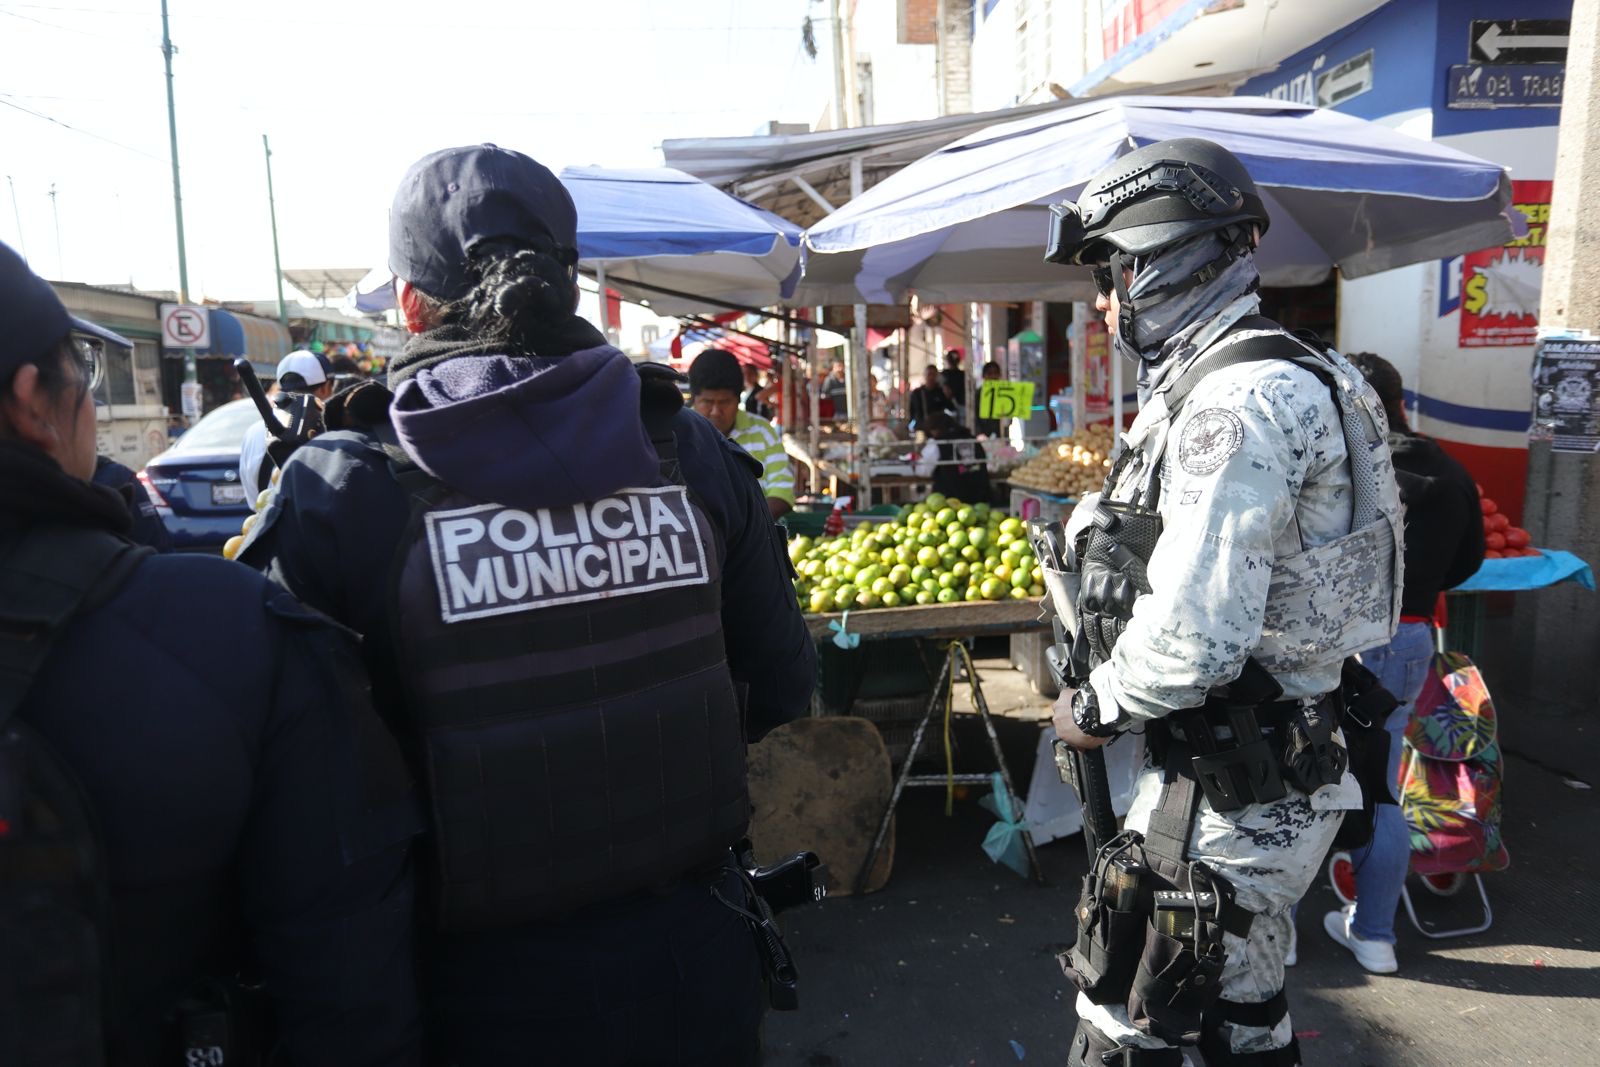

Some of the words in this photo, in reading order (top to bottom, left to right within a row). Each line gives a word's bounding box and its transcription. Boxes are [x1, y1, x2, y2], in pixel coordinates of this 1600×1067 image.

[1522, 75, 1565, 97] TRAB
[1464, 273, 1488, 314] $
[176, 315, 193, 336] E
[984, 386, 1016, 417] 15
[440, 495, 687, 562] POLICIA
[446, 534, 697, 609] MUNICIPAL
